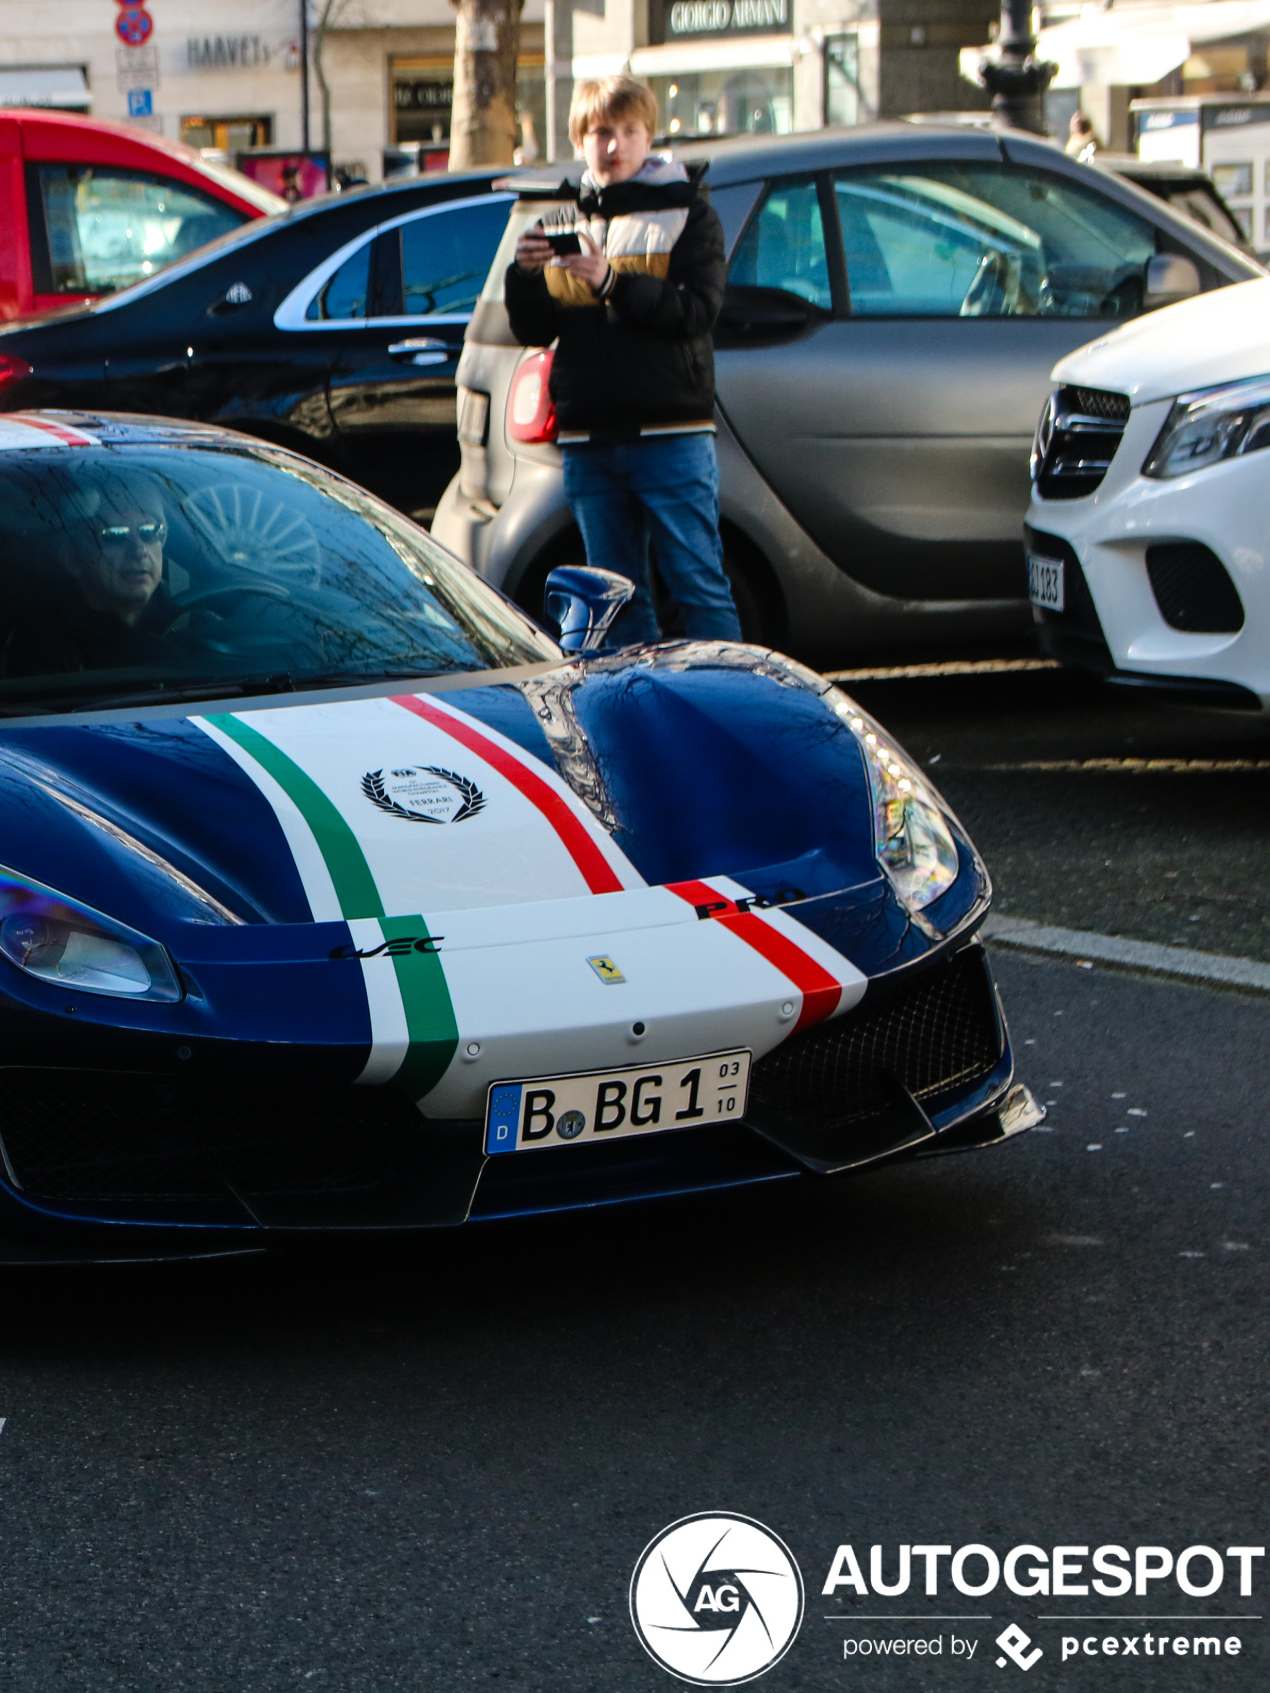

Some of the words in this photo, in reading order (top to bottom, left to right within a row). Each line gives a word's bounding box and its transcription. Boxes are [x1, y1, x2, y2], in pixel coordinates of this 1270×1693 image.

[671, 1, 730, 34] GIORGIO
[731, 0, 788, 28] ARMANI
[409, 796, 454, 807] FERRARI
[428, 807, 450, 815] 2017
[718, 1061, 740, 1078] 03
[496, 1125, 509, 1140] D
[521, 1088, 556, 1142] B
[593, 1074, 663, 1133] BG
[675, 1067, 705, 1121] 1
[717, 1096, 736, 1114] 10
